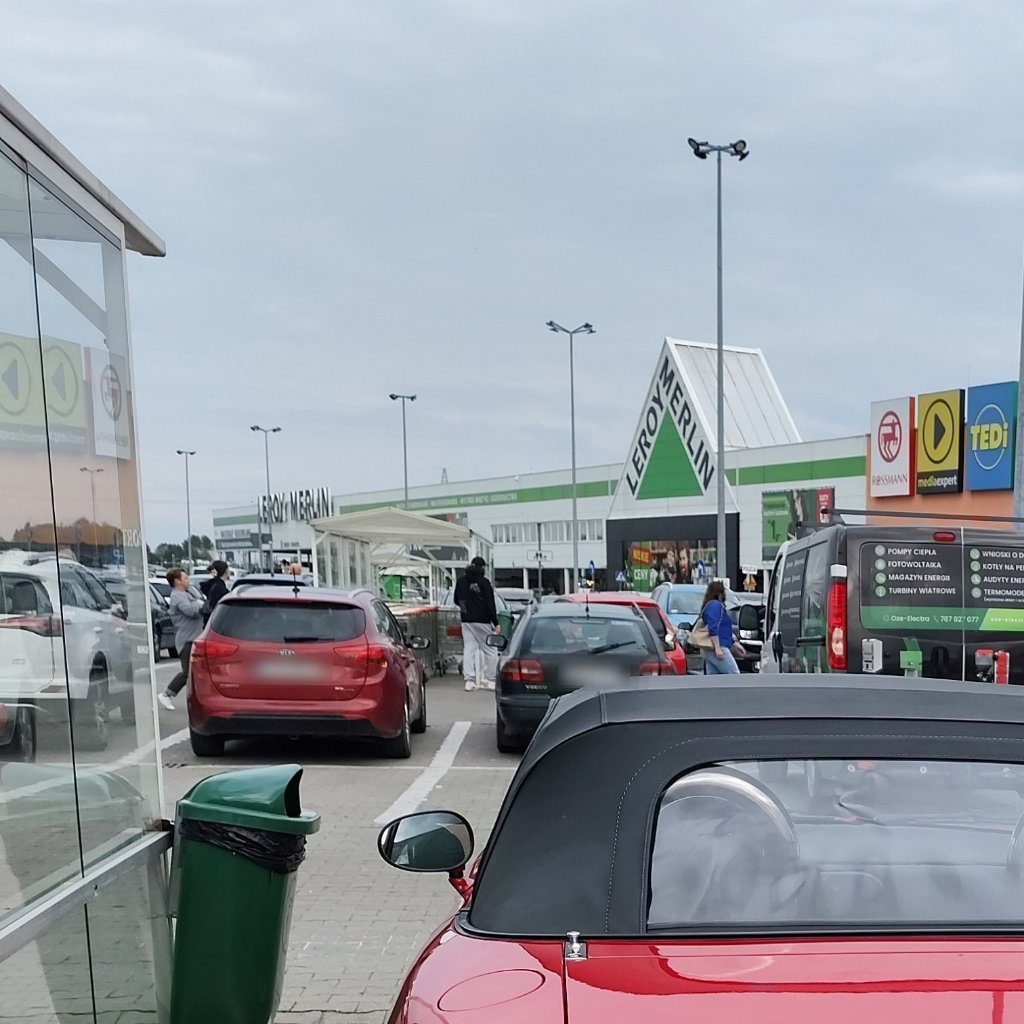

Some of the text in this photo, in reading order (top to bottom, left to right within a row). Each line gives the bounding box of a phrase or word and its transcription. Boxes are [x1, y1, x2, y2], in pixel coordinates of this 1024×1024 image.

[626, 355, 715, 495] LEROY MERLIN
[970, 423, 1008, 451] TEDi
[872, 474, 908, 487] ROSSMANN
[917, 474, 958, 488] mediaexpert
[258, 487, 330, 524] LEROY MERLIN
[887, 560, 942, 568] FOTOWOLTAIKA
[633, 568, 649, 580] CENY
[918, 587, 957, 595] WIATROWE
[940, 615, 952, 623] 787
